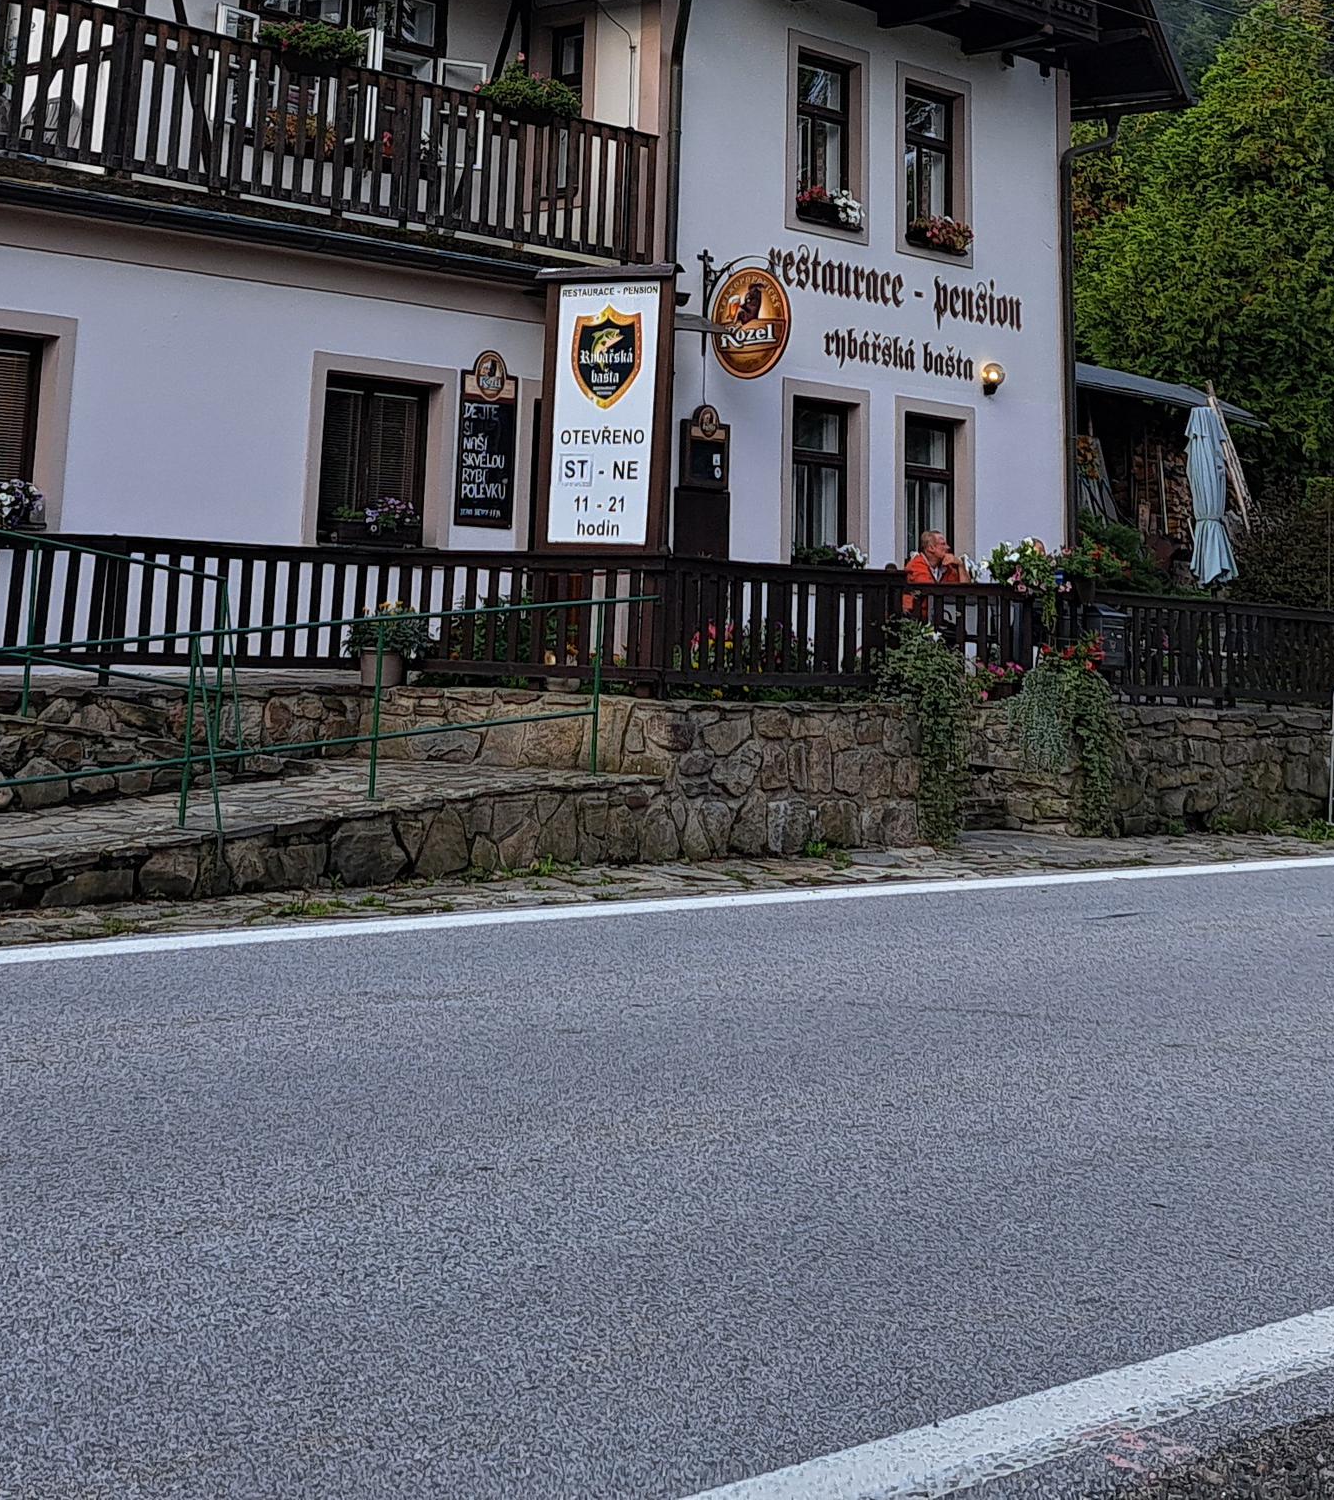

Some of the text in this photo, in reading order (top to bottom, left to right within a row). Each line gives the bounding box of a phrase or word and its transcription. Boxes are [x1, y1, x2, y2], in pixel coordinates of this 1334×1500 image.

[562, 287, 615, 298] RESTAURACE
[623, 285, 658, 296] PENSION
[768, 244, 1023, 332] restaurace - pension
[720, 323, 777, 349] Kozel
[823, 327, 975, 382] rybářská bašta
[591, 368, 620, 384] bašta
[463, 402, 500, 421] DEJTE
[463, 420, 474, 436] SI
[560, 425, 645, 445] OTEVŘENO
[564, 459, 588, 479] ST
[613, 460, 639, 480] NE
[574, 495, 588, 513] 11
[608, 495, 625, 513] 21
[576, 519, 620, 537] hodin
